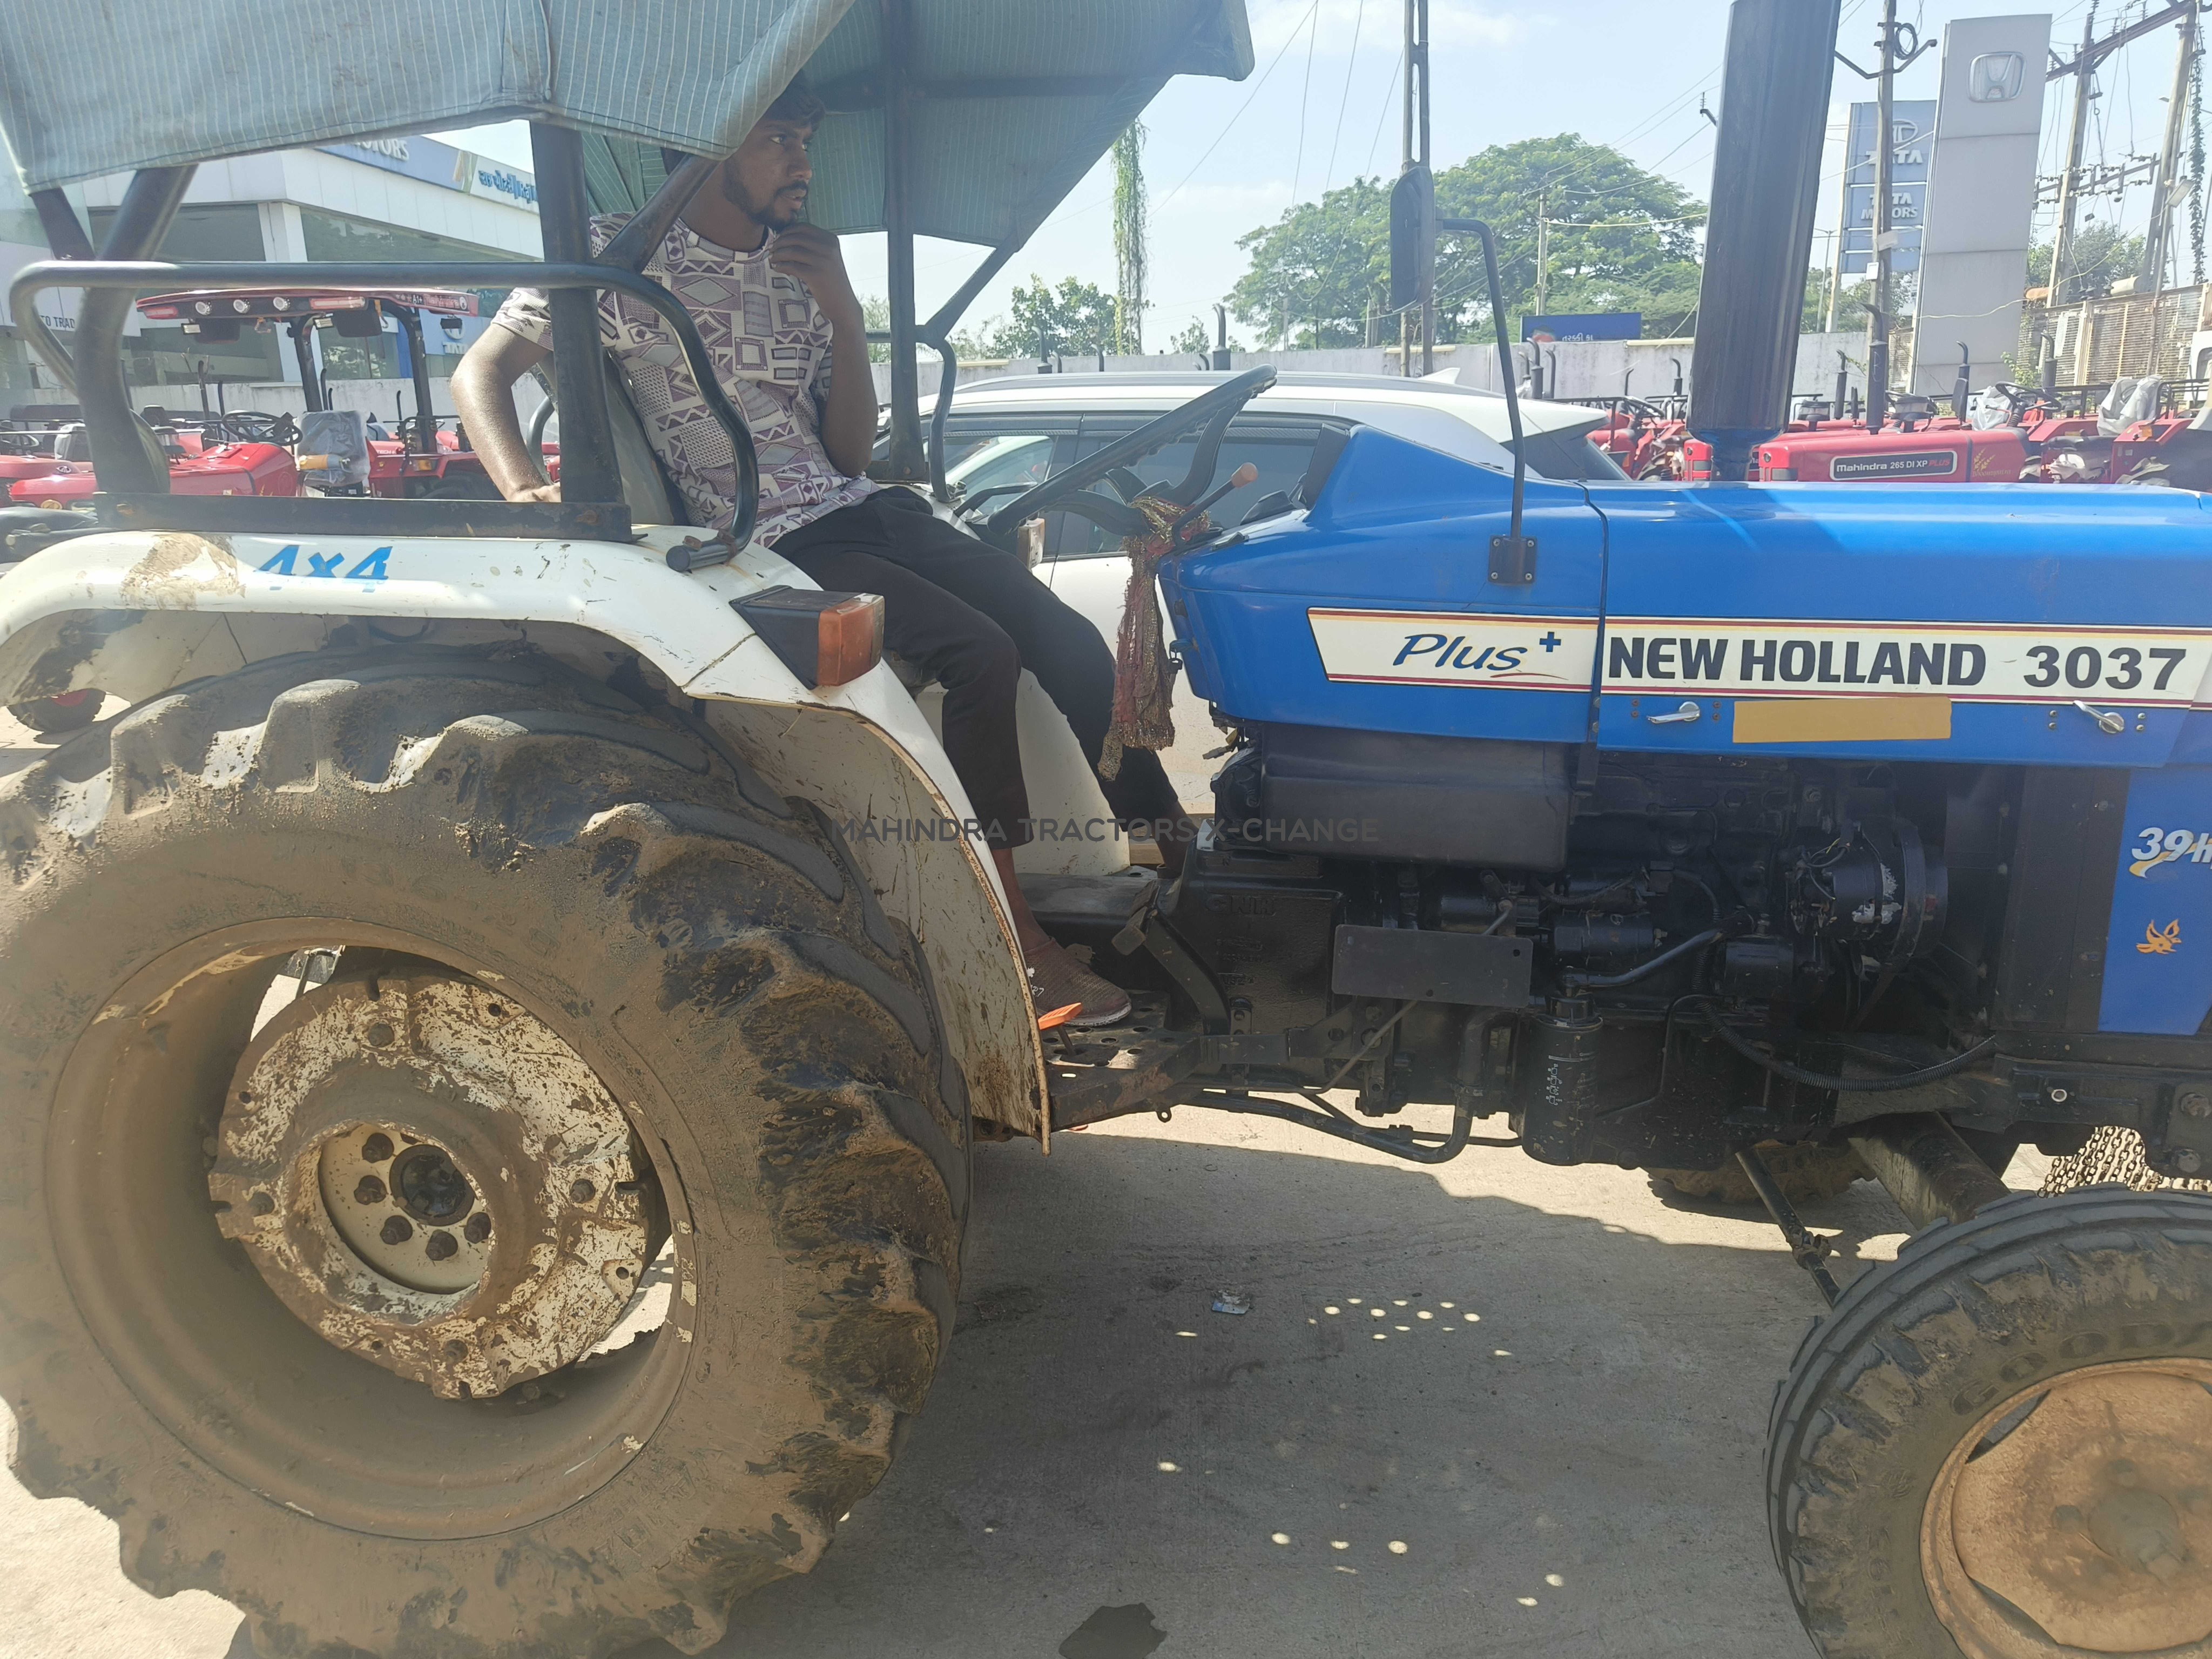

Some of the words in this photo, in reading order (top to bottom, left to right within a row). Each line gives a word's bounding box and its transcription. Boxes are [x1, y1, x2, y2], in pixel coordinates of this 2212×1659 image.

[1866, 150, 1923, 164] TTA
[1861, 207, 1918, 219] MORS
[1836, 462, 1887, 473] Mahindra
[1890, 461, 1905, 469] 265
[1609, 637, 1728, 680] NEW
[1740, 639, 1987, 686] HOLLAND
[2024, 645, 2187, 690] 3037
